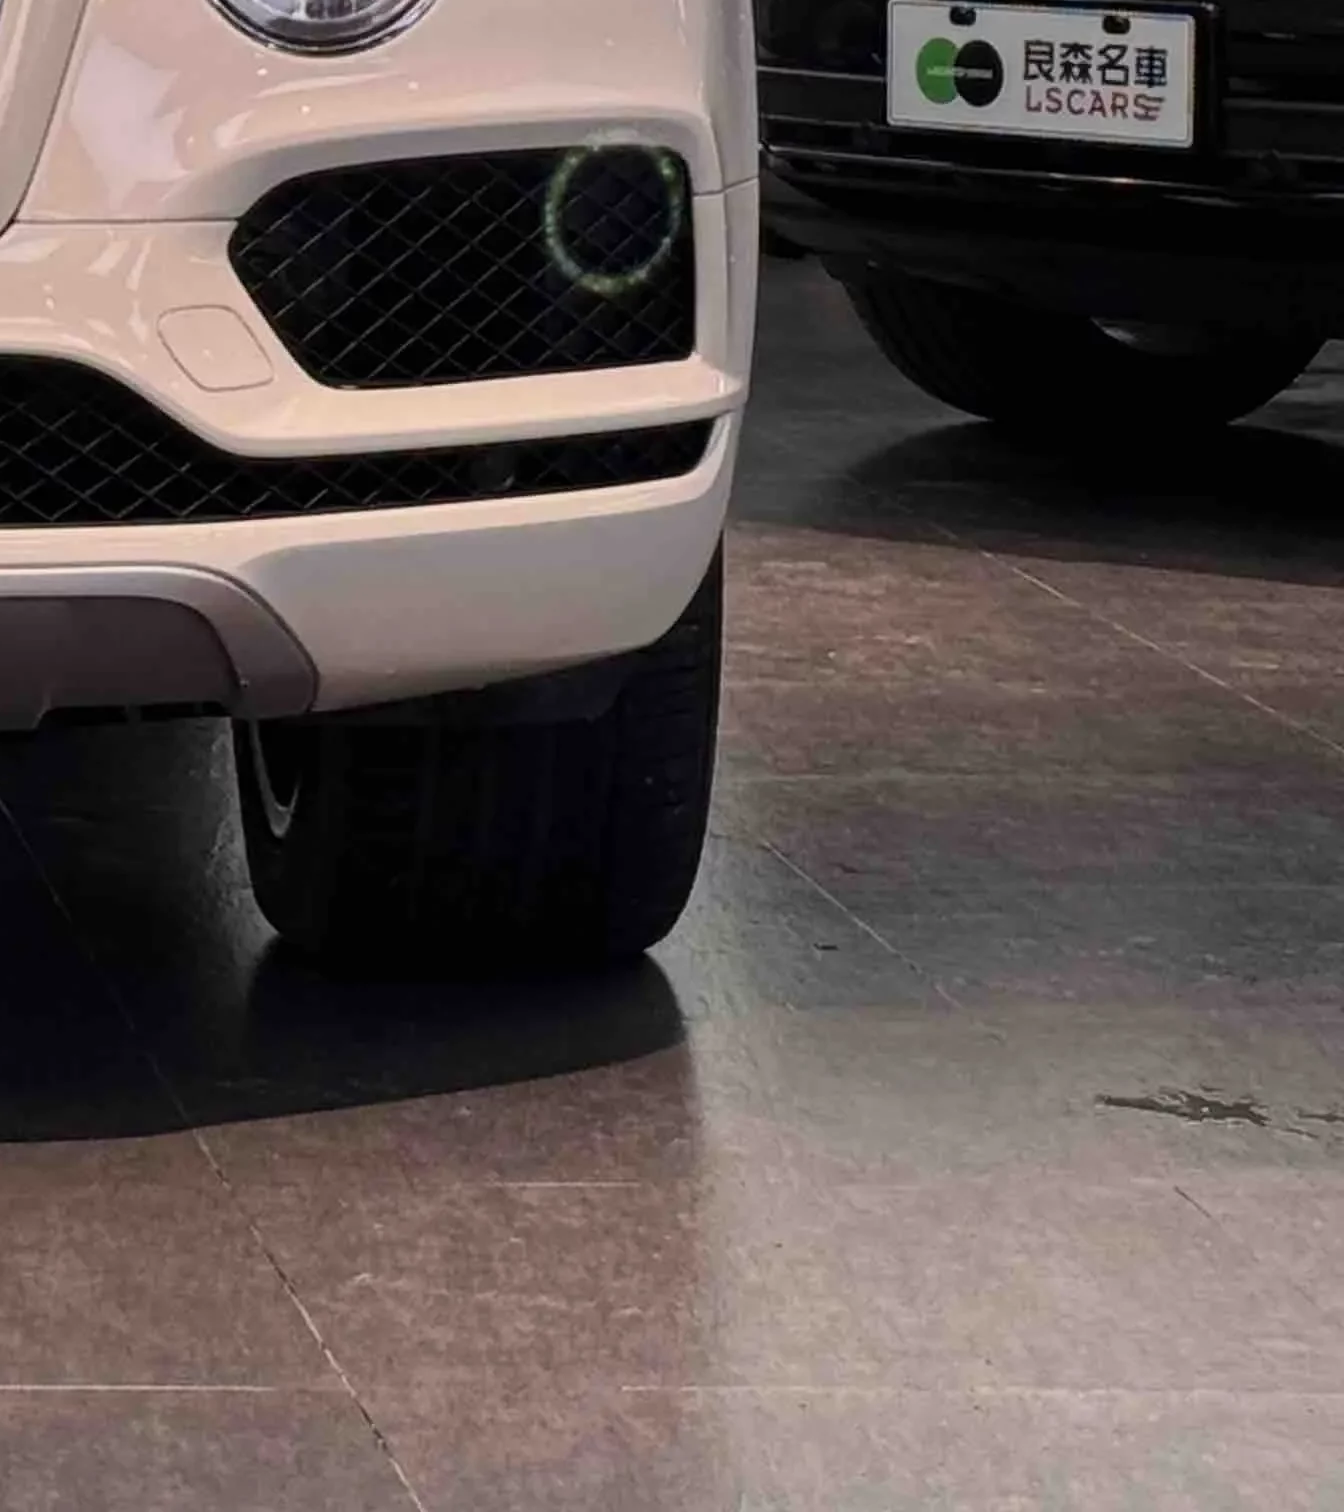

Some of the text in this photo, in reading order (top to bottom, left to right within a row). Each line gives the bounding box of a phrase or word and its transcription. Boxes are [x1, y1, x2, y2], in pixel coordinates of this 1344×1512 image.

[1023, 40, 1168, 89] 良森名車
[1025, 86, 1165, 121] LSCARS
